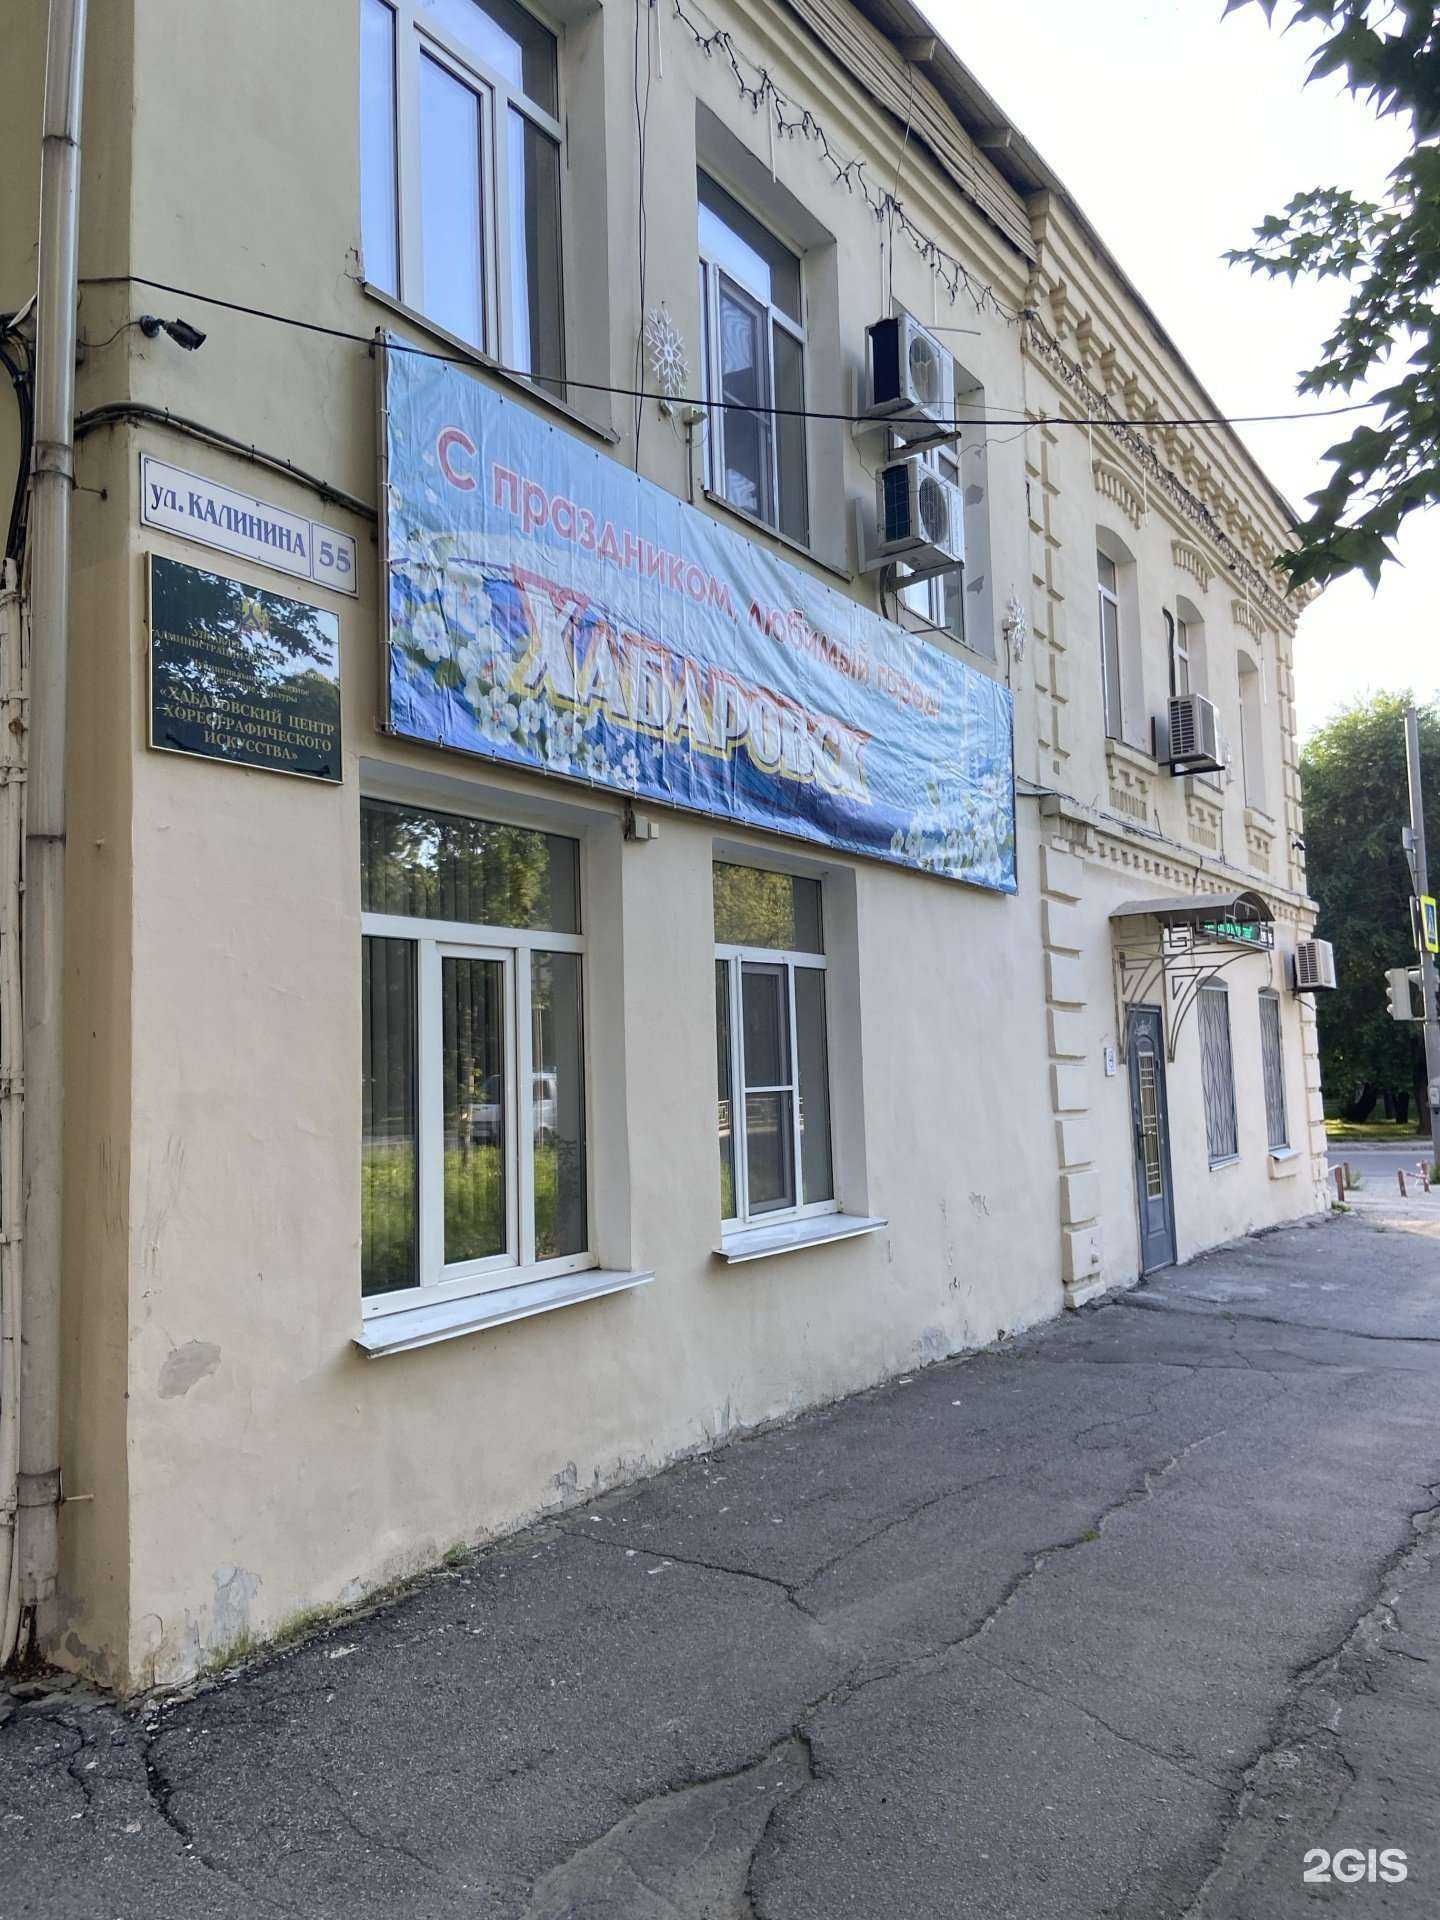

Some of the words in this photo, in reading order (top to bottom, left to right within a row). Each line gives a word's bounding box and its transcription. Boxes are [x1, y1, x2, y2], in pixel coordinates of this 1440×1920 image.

[150, 483, 184, 512] ул.
[187, 493, 306, 558] КАЛИНИНА
[318, 540, 352, 574] 55
[437, 426, 476, 491] С
[748, 598, 868, 682] любимый
[288, 714, 334, 737] ЦЕНТР
